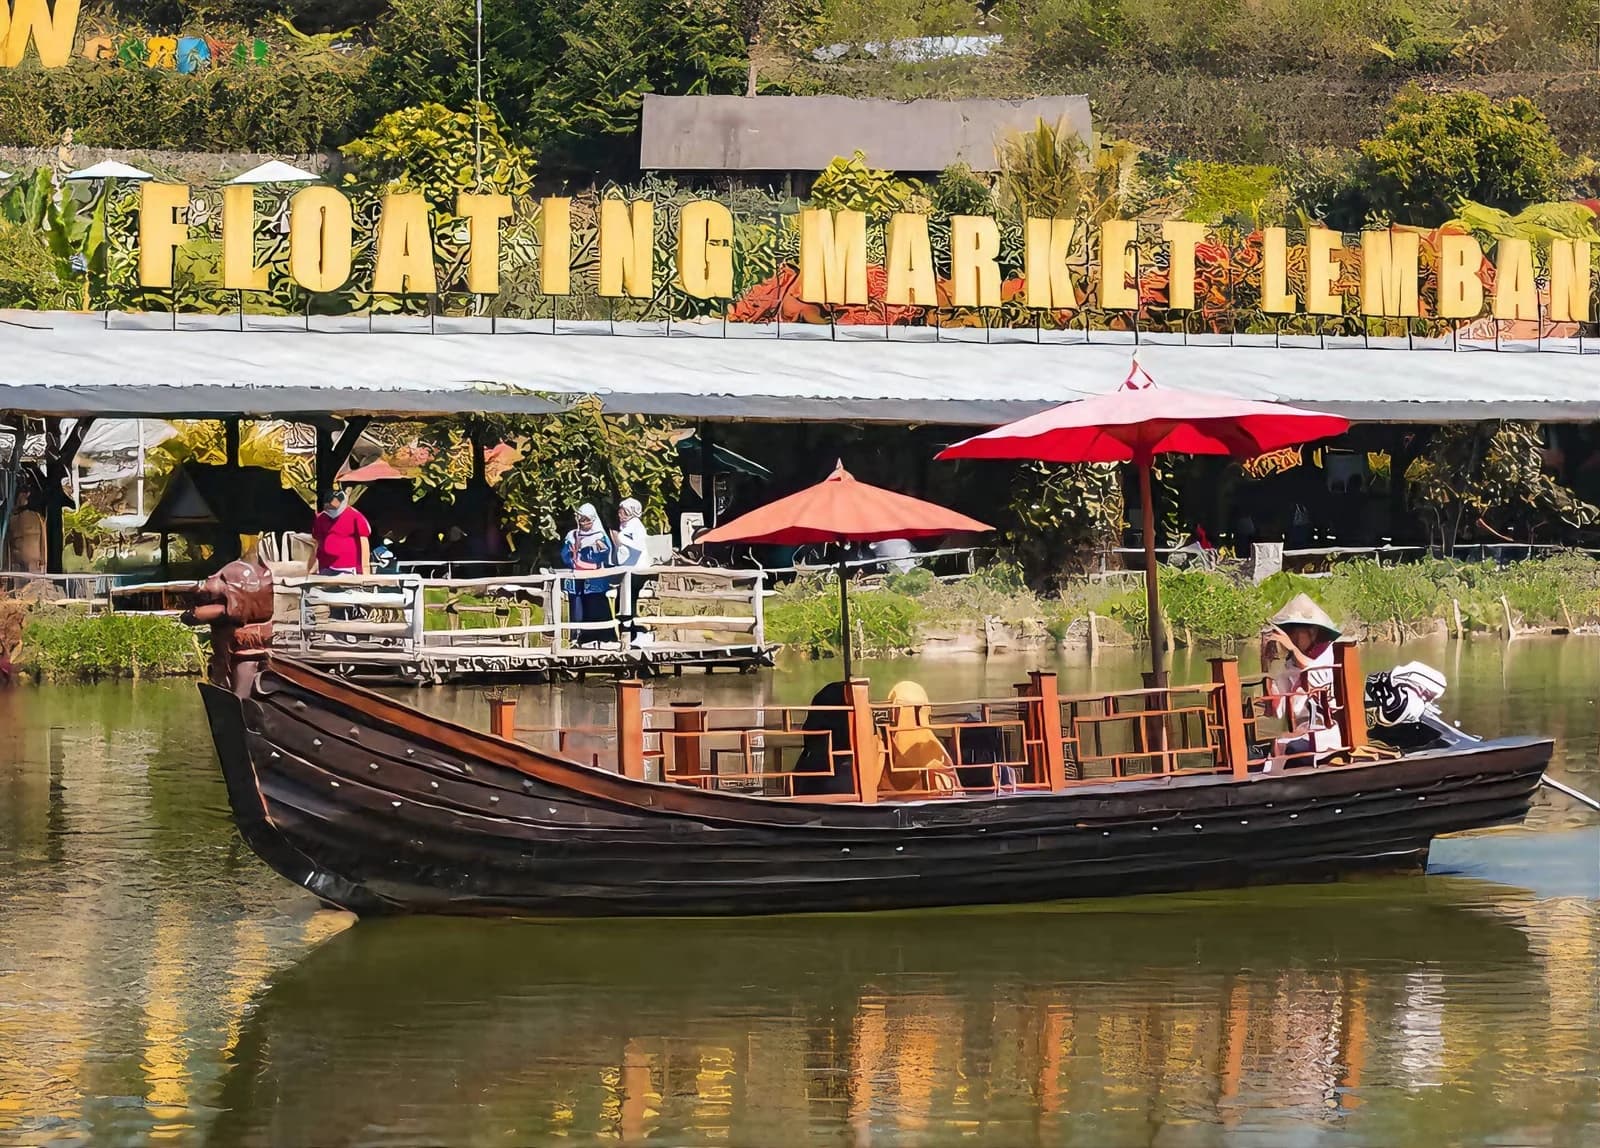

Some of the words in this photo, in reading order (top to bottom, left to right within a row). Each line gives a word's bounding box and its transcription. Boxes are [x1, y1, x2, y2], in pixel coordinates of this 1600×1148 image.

[138, 182, 735, 299] FLOATING
[800, 206, 1204, 311] MARKET
[1262, 226, 1591, 322] LEMBAN
